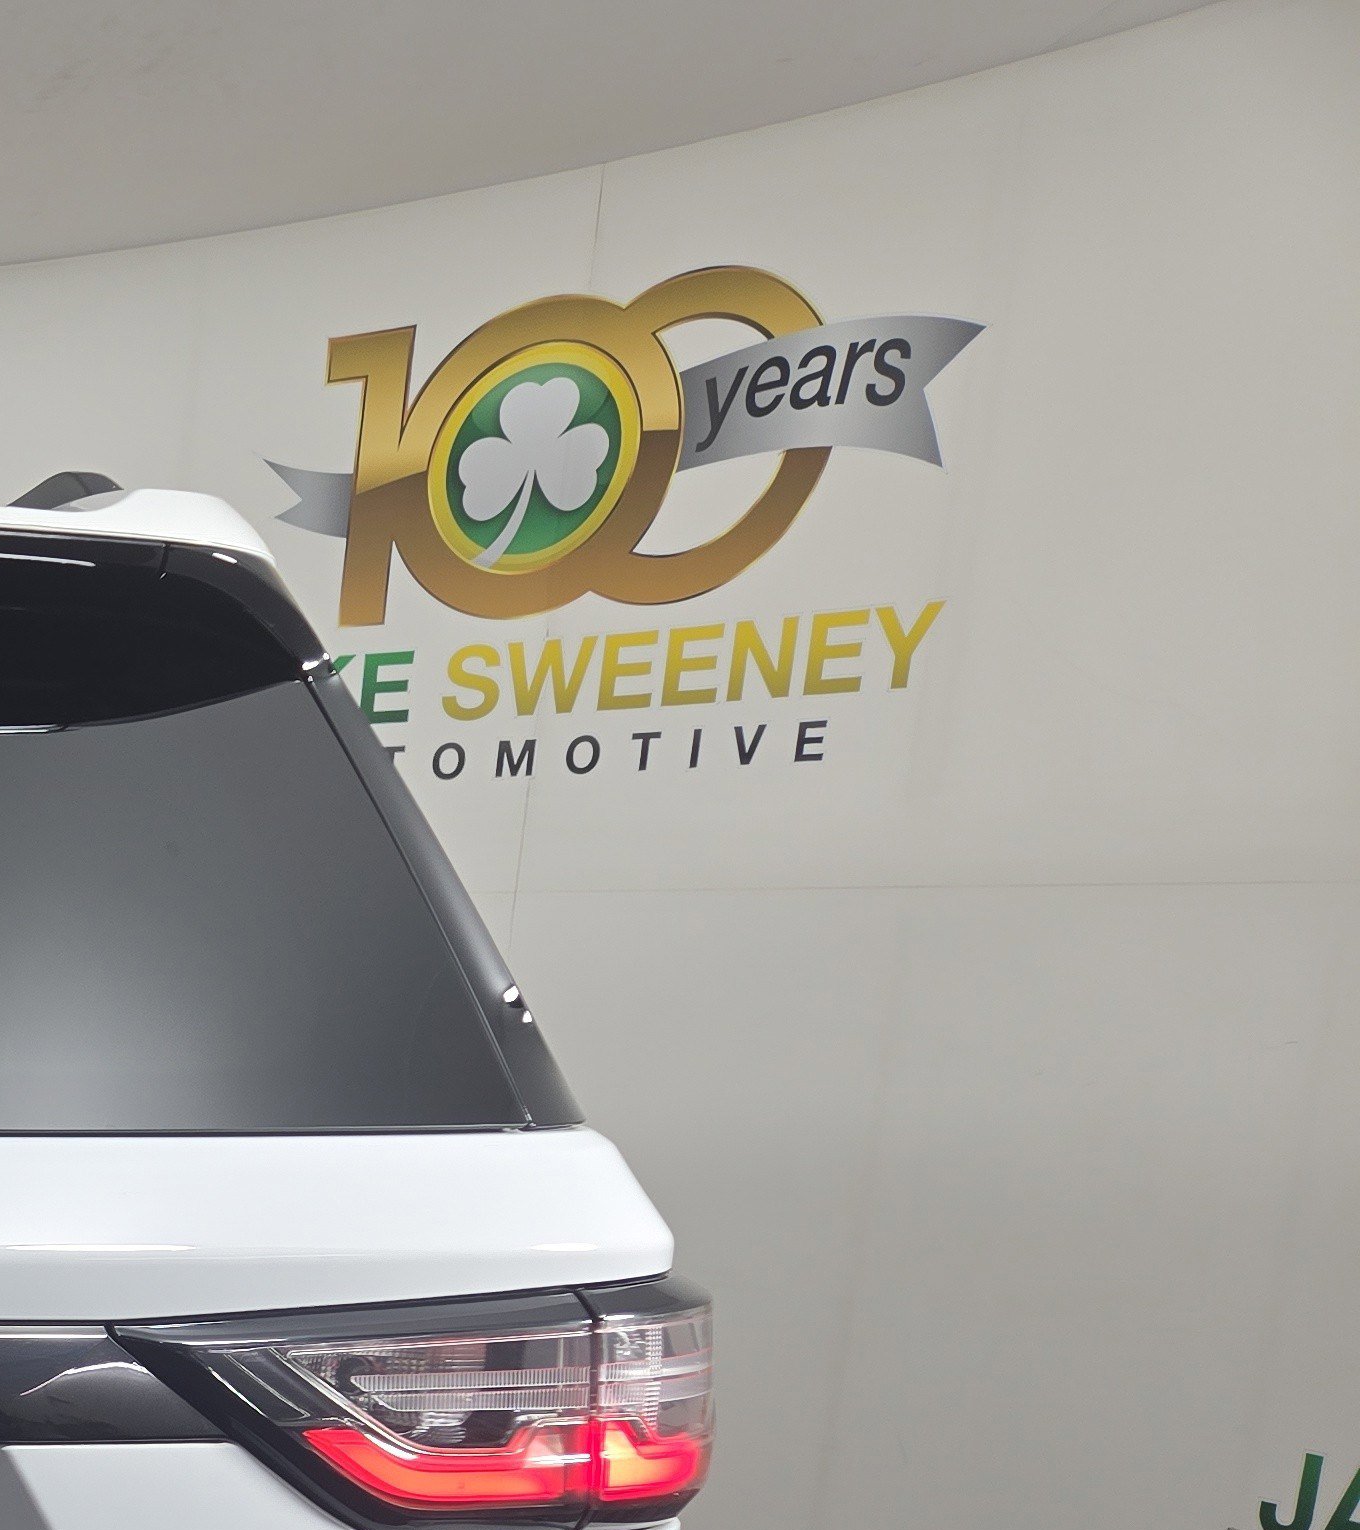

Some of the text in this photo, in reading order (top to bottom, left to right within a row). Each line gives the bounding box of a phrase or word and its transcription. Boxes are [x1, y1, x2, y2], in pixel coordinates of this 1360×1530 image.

[693, 334, 911, 453] years
[440, 600, 947, 722] SWEENEY
[383, 719, 829, 782] OMOTIVE
